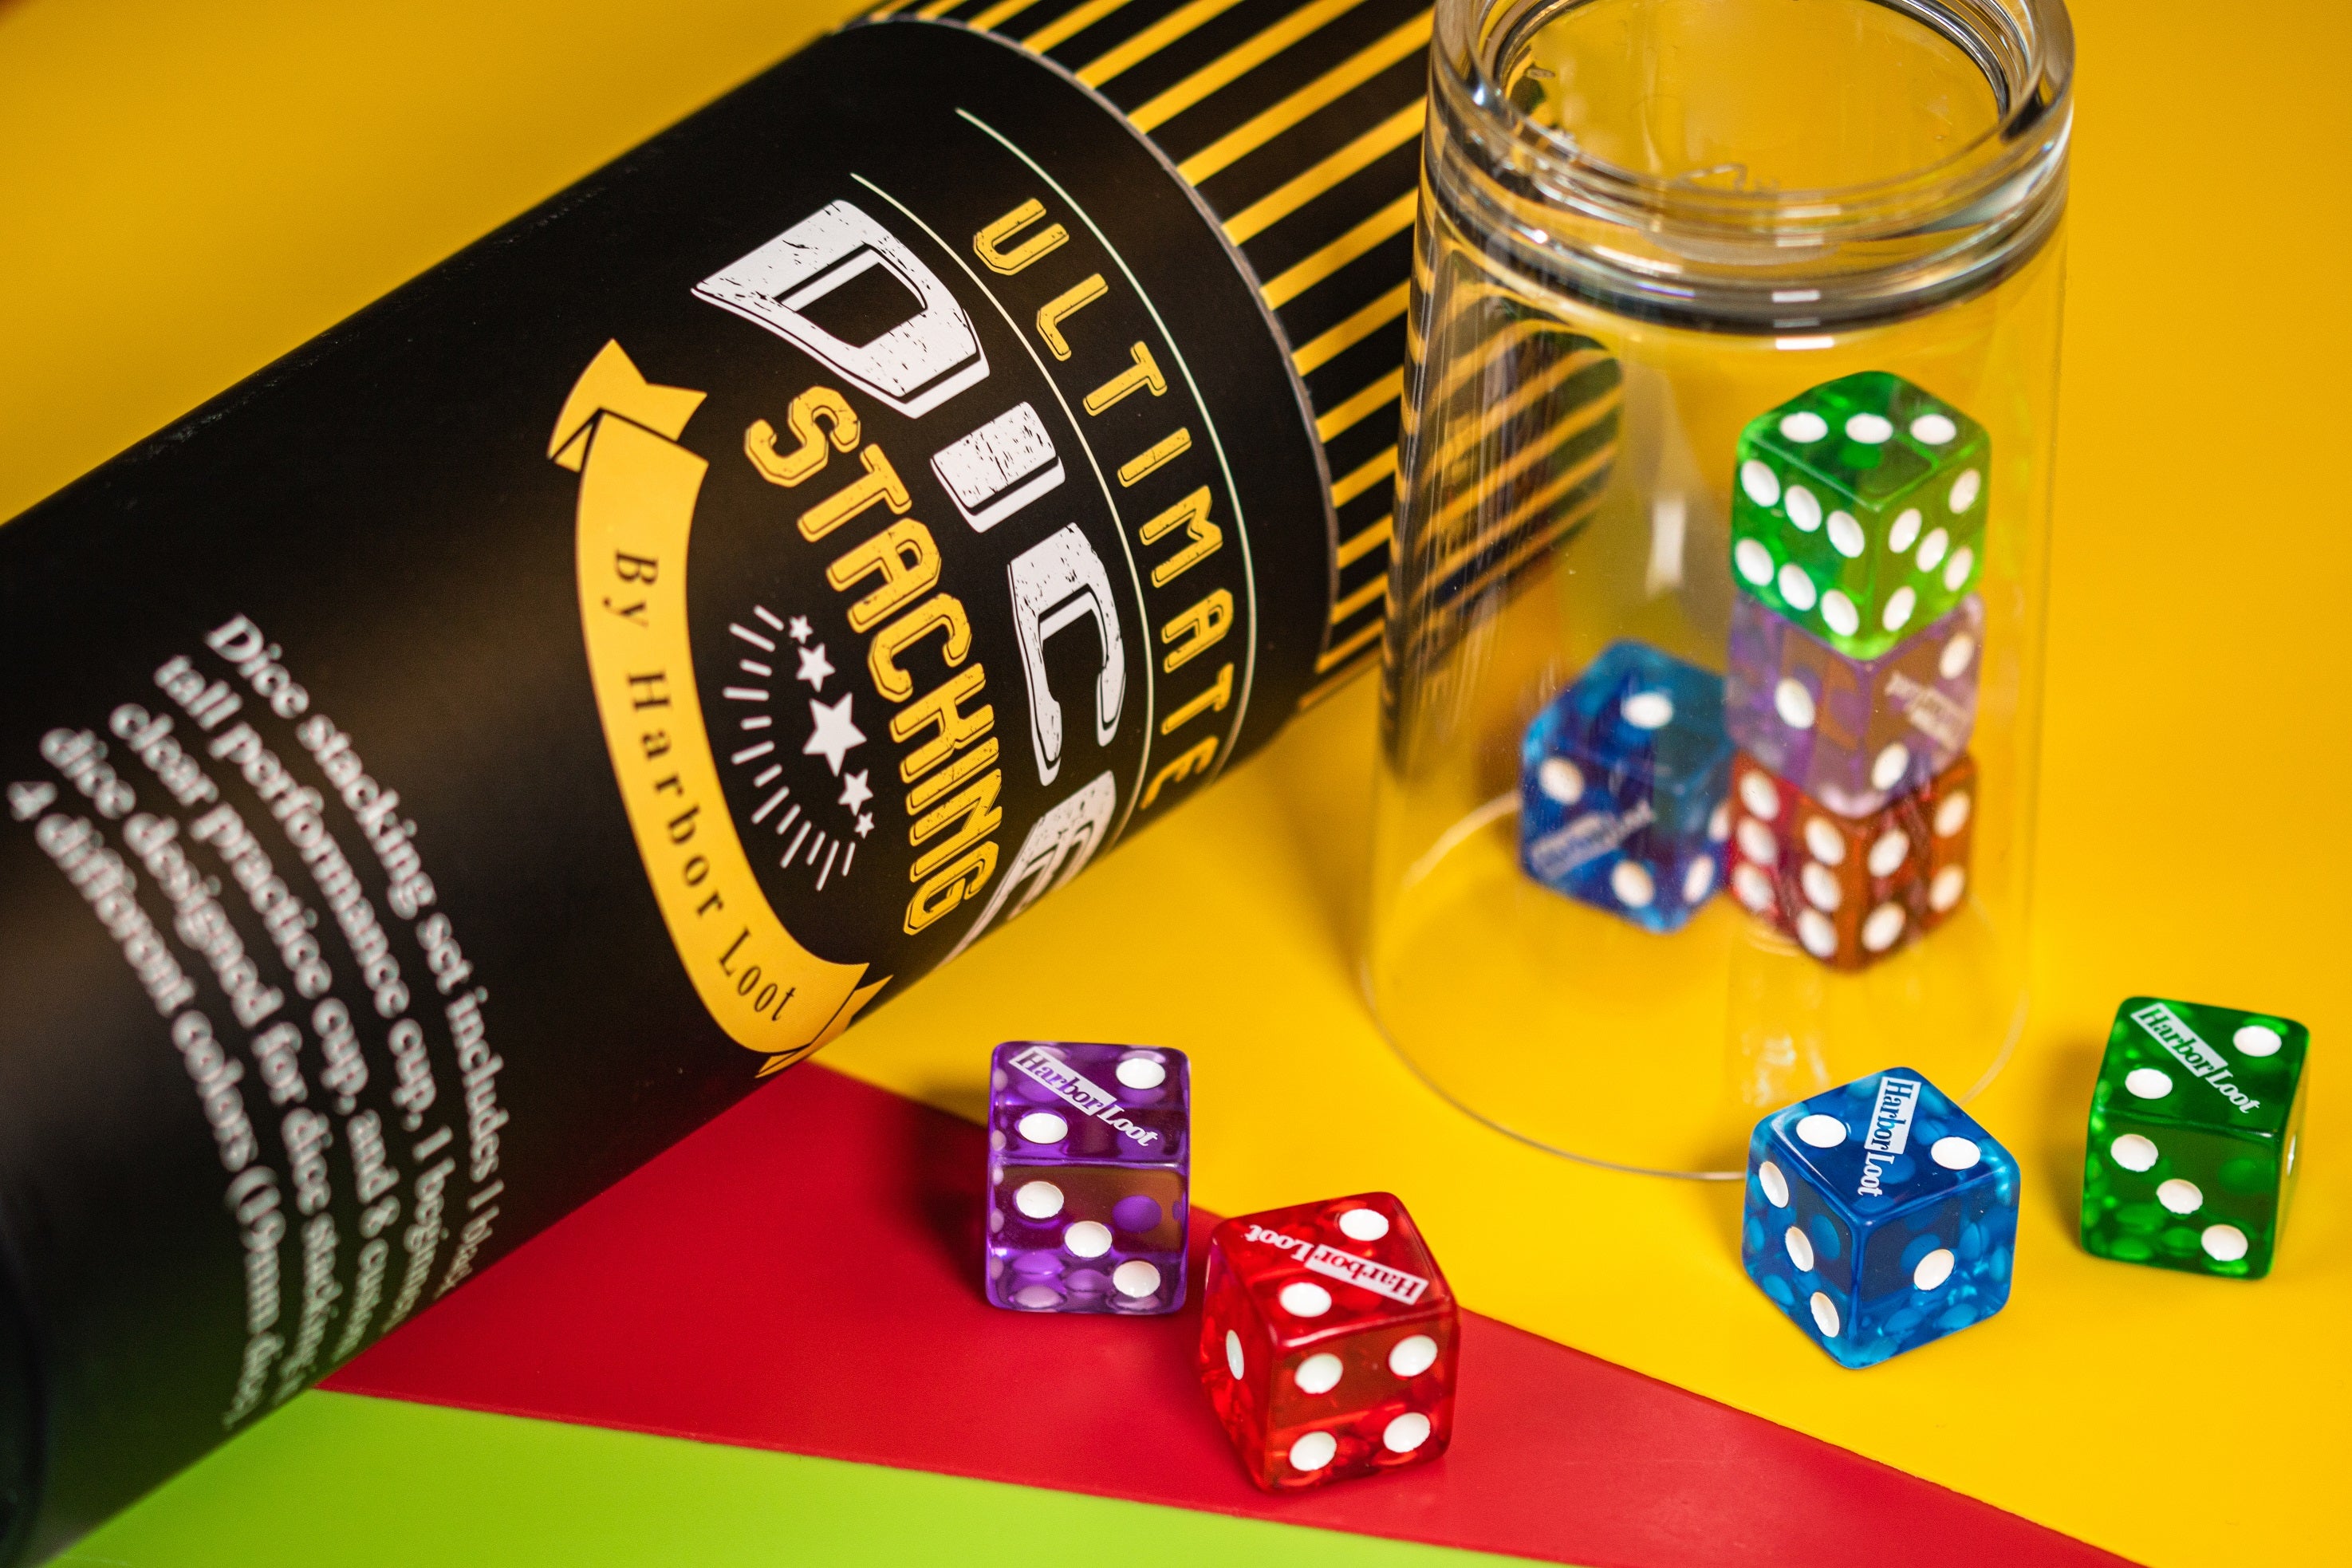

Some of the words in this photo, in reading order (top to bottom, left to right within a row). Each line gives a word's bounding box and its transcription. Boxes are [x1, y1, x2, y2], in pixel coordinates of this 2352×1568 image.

[690, 199, 1126, 971] DICE
[972, 197, 1235, 810] ULTIMATE
[602, 549, 660, 628] By
[743, 385, 1003, 936] STACKING
[626, 670, 725, 917] Harbor
[39, 727, 136, 819] dice
[123, 812, 285, 1029] designed
[250, 1021, 309, 1106] for
[281, 1107, 333, 1216] dice
[108, 703, 219, 808] clear
[188, 799, 333, 999] practice
[311, 996, 369, 1117] cup,
[346, 1109, 399, 1204] and
[153, 654, 242, 731] tall
[207, 719, 411, 1018] performance
[388, 1017, 436, 1132] cup,
[204, 613, 309, 719] Dice
[296, 714, 436, 919] stacking
[415, 912, 474, 995] set
[445, 986, 509, 1182] includes
[718, 926, 797, 1022] Loot
[171, 1009, 259, 1173] colors
[1013, 1048, 1113, 1115] Harbor
[1097, 1104, 1160, 1148] Loot
[1867, 1077, 1917, 1154] Harbor
[2133, 1005, 2222, 1077] Harbor
[2204, 1067, 2262, 1115] Loot
[1244, 1223, 1314, 1263] Loot
[1857, 1150, 1897, 1198] Loot
[1308, 1245, 1423, 1302] Harbor
